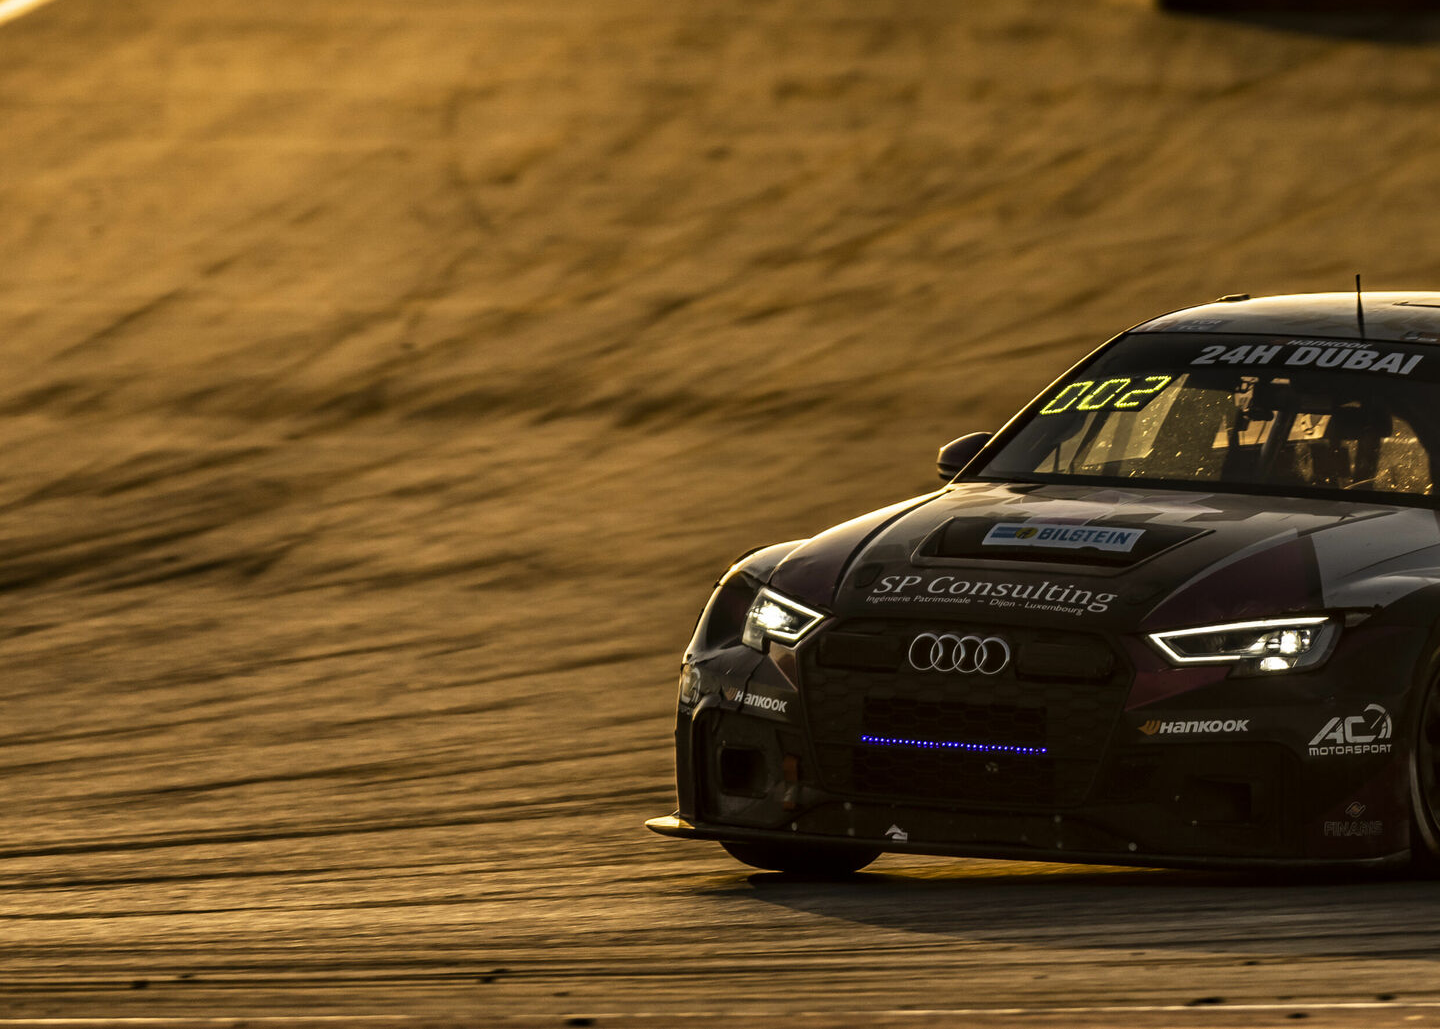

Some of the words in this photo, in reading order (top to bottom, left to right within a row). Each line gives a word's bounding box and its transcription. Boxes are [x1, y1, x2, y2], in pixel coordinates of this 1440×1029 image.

[1190, 345, 1284, 365] 24H
[1284, 346, 1424, 375] DUBAI
[1039, 375, 1172, 415] 002
[1037, 527, 1132, 545] BILSTEIN
[873, 575, 922, 595] SP
[927, 576, 1119, 613] Consulting
[913, 595, 972, 605] Patrimoniale
[989, 598, 1016, 609] Dijon
[1024, 601, 1085, 617] Luxembourg
[1308, 744, 1393, 756] MOTORSPORT
